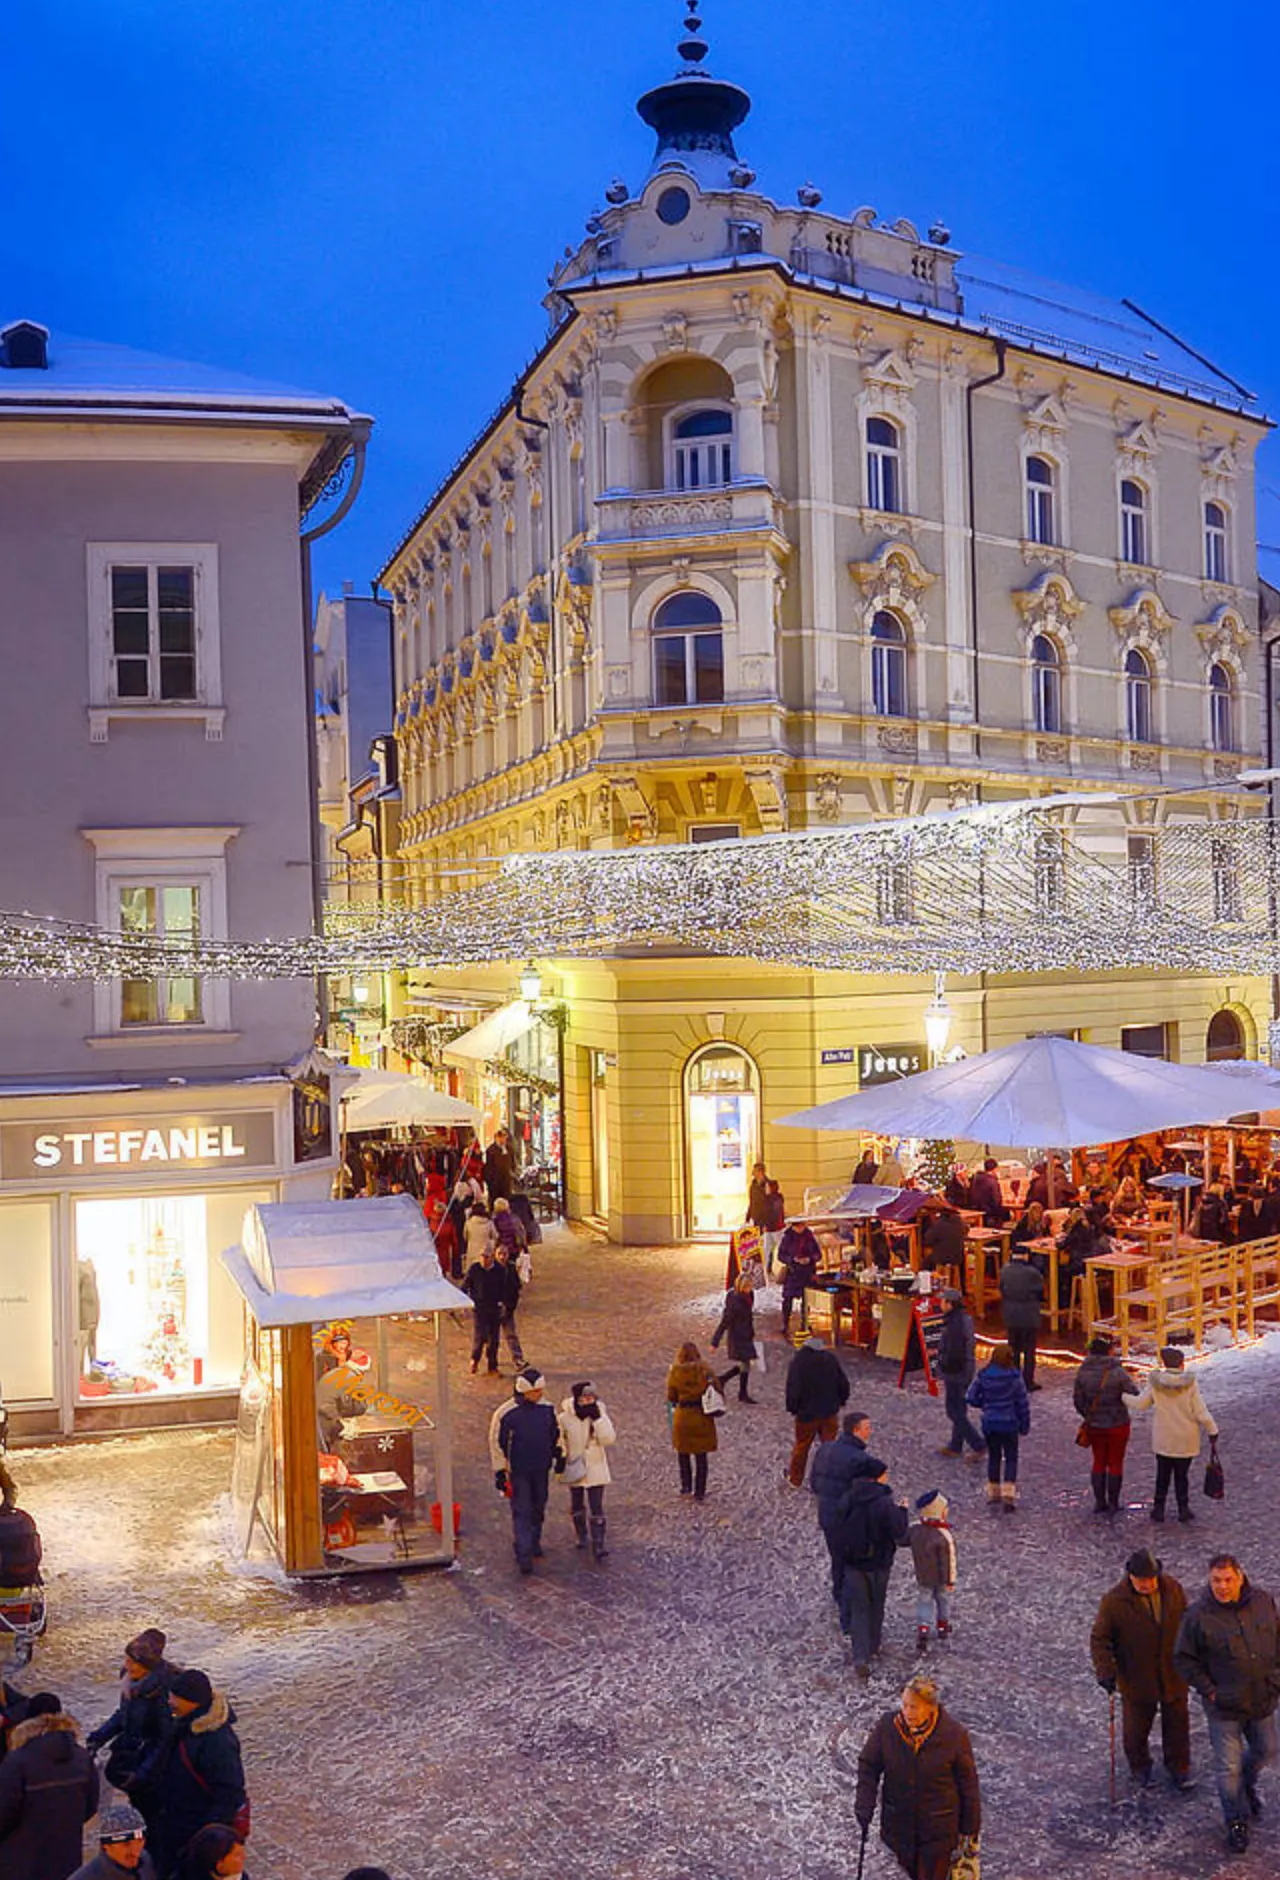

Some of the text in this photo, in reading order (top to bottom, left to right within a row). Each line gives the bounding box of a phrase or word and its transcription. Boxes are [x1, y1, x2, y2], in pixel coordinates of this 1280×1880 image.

[861, 1053, 919, 1078] Jones
[33, 1125, 245, 1167] STEFANEL
[323, 1367, 433, 1426] Maroni
